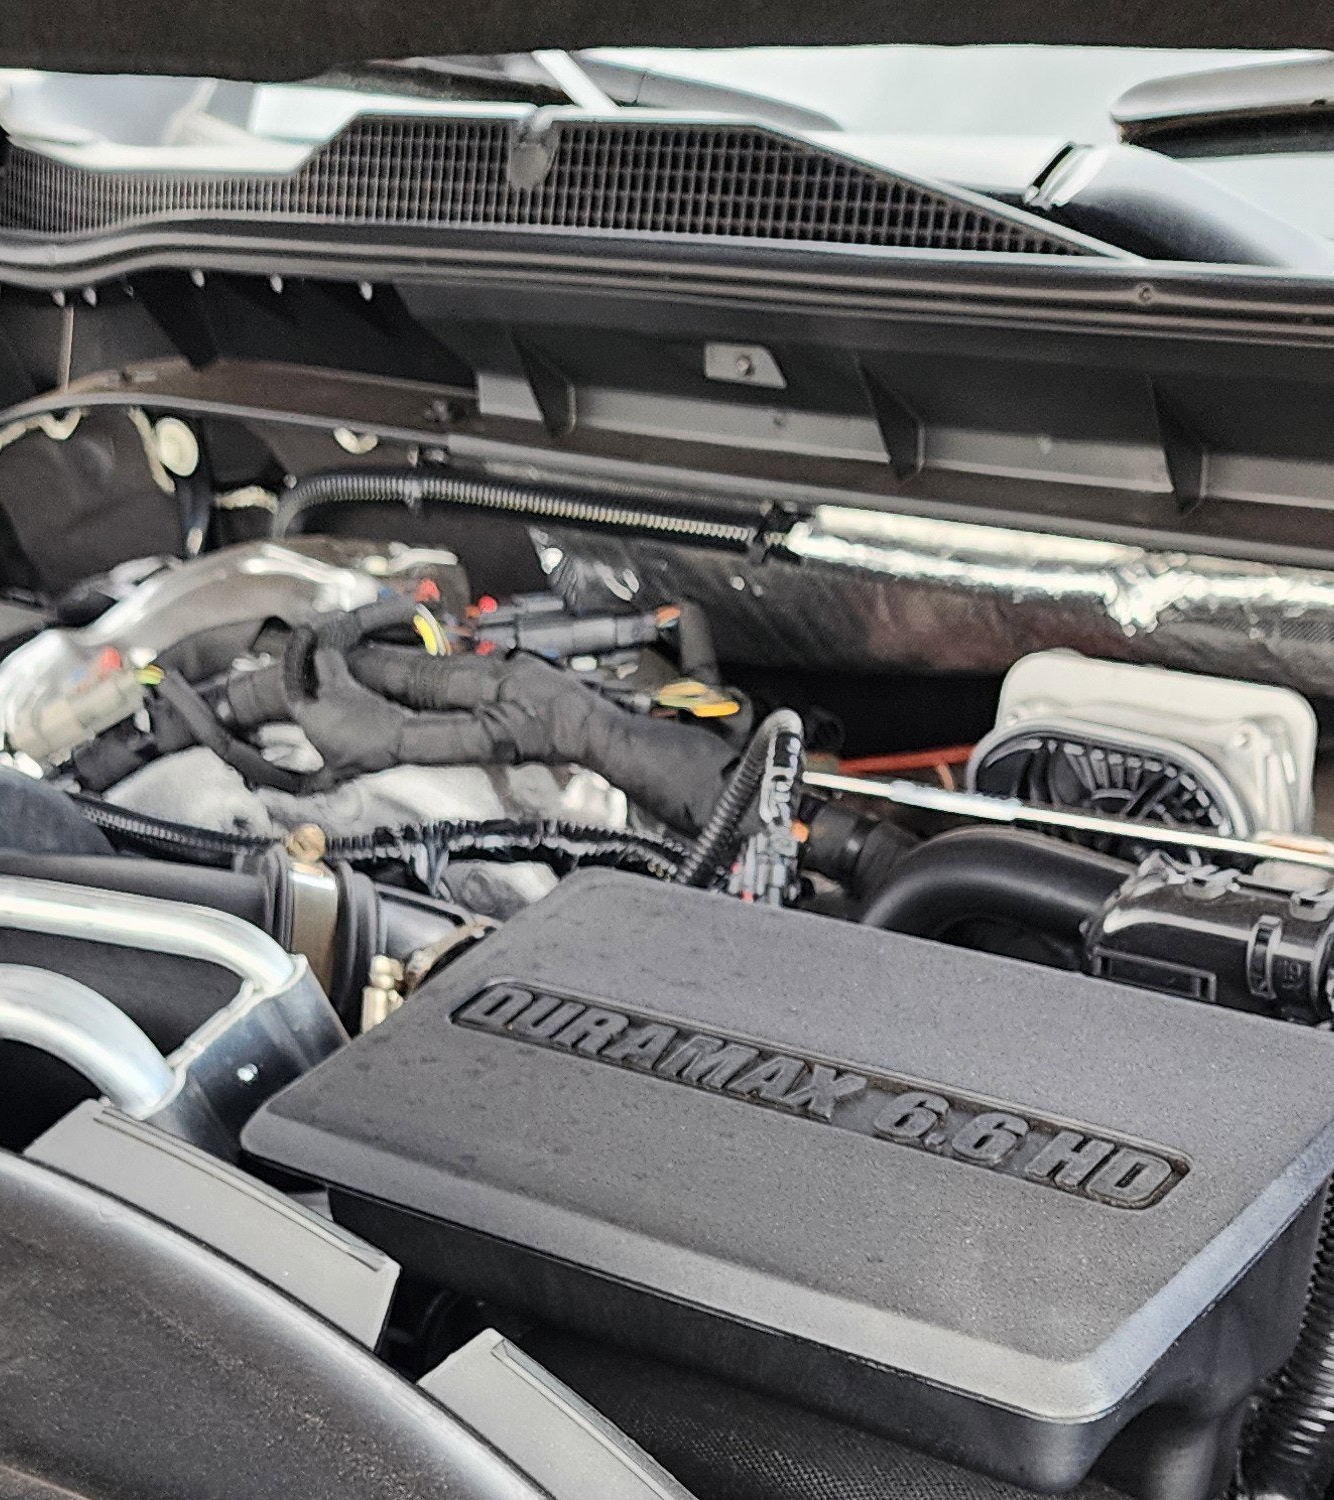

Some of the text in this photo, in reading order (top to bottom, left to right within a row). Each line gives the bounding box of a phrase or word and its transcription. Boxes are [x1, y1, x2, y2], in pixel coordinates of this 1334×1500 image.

[470, 984, 1174, 1206] DURAMAX 6.6 HD
